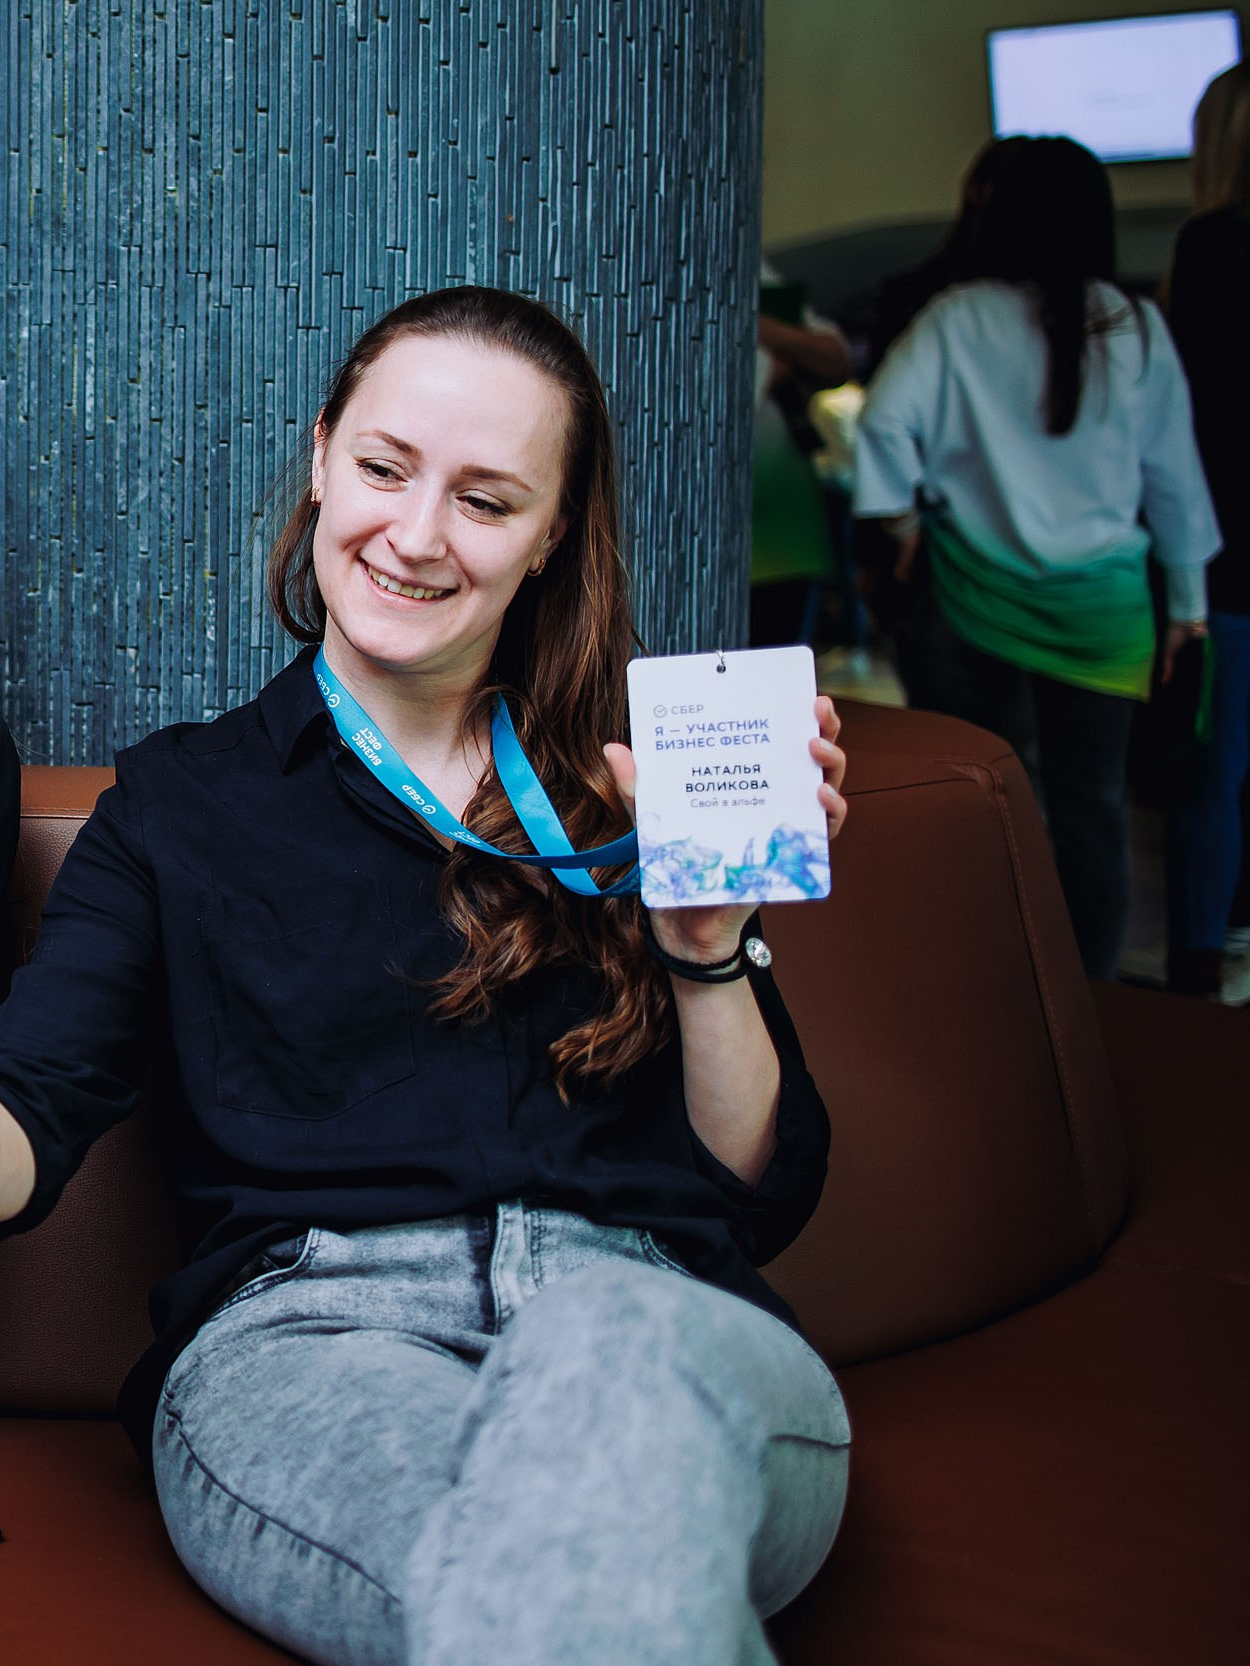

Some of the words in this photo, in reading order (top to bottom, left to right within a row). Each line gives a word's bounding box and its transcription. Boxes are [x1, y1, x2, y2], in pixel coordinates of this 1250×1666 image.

[316, 673, 330, 696] СБЕР
[670, 704, 705, 715] СБЕР
[654, 726, 664, 737] Я
[686, 718, 770, 735] УЧАСТНИК
[359, 727, 383, 751] ФЕСТ
[655, 736, 716, 751] БИЗНЕС
[719, 733, 770, 746] ФЕСТА
[351, 732, 383, 767] БИЗНЕС
[691, 763, 761, 777] НАТАЛЬЯ
[401, 784, 426, 806] СБЕР
[685, 779, 770, 793] ВОЛИКОВА
[690, 797, 718, 808] Свой
[731, 796, 766, 808] альфе
